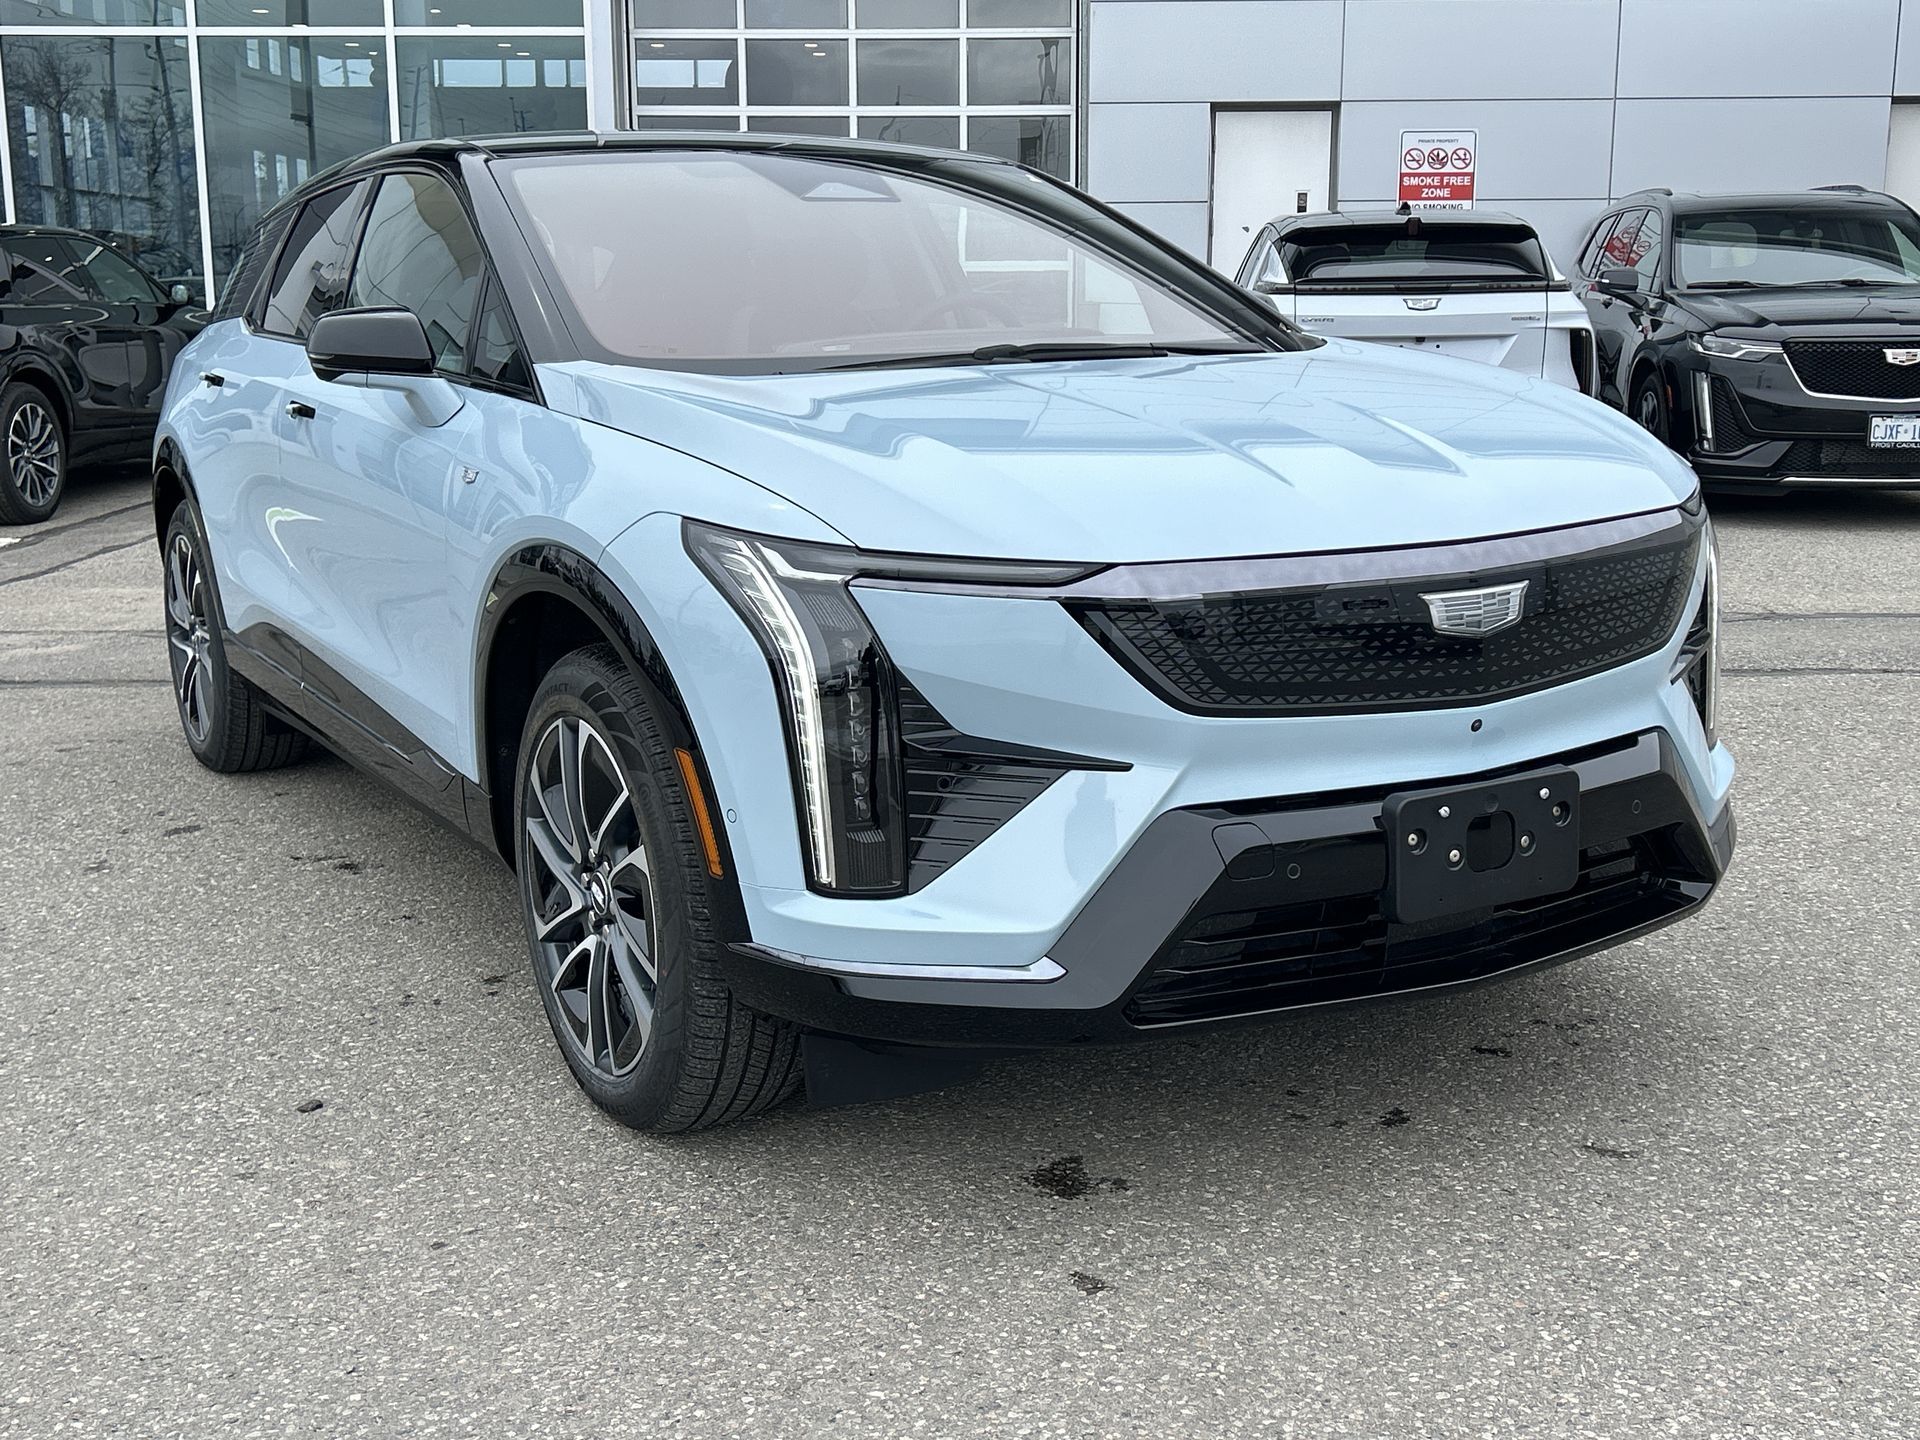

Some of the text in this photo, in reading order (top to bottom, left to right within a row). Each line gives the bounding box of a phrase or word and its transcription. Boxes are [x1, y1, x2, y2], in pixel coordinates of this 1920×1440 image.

[1402, 176, 1471, 186] SMOKE FREE
[1421, 188, 1451, 198] ZONE
[1872, 424, 1904, 440] CJXF
